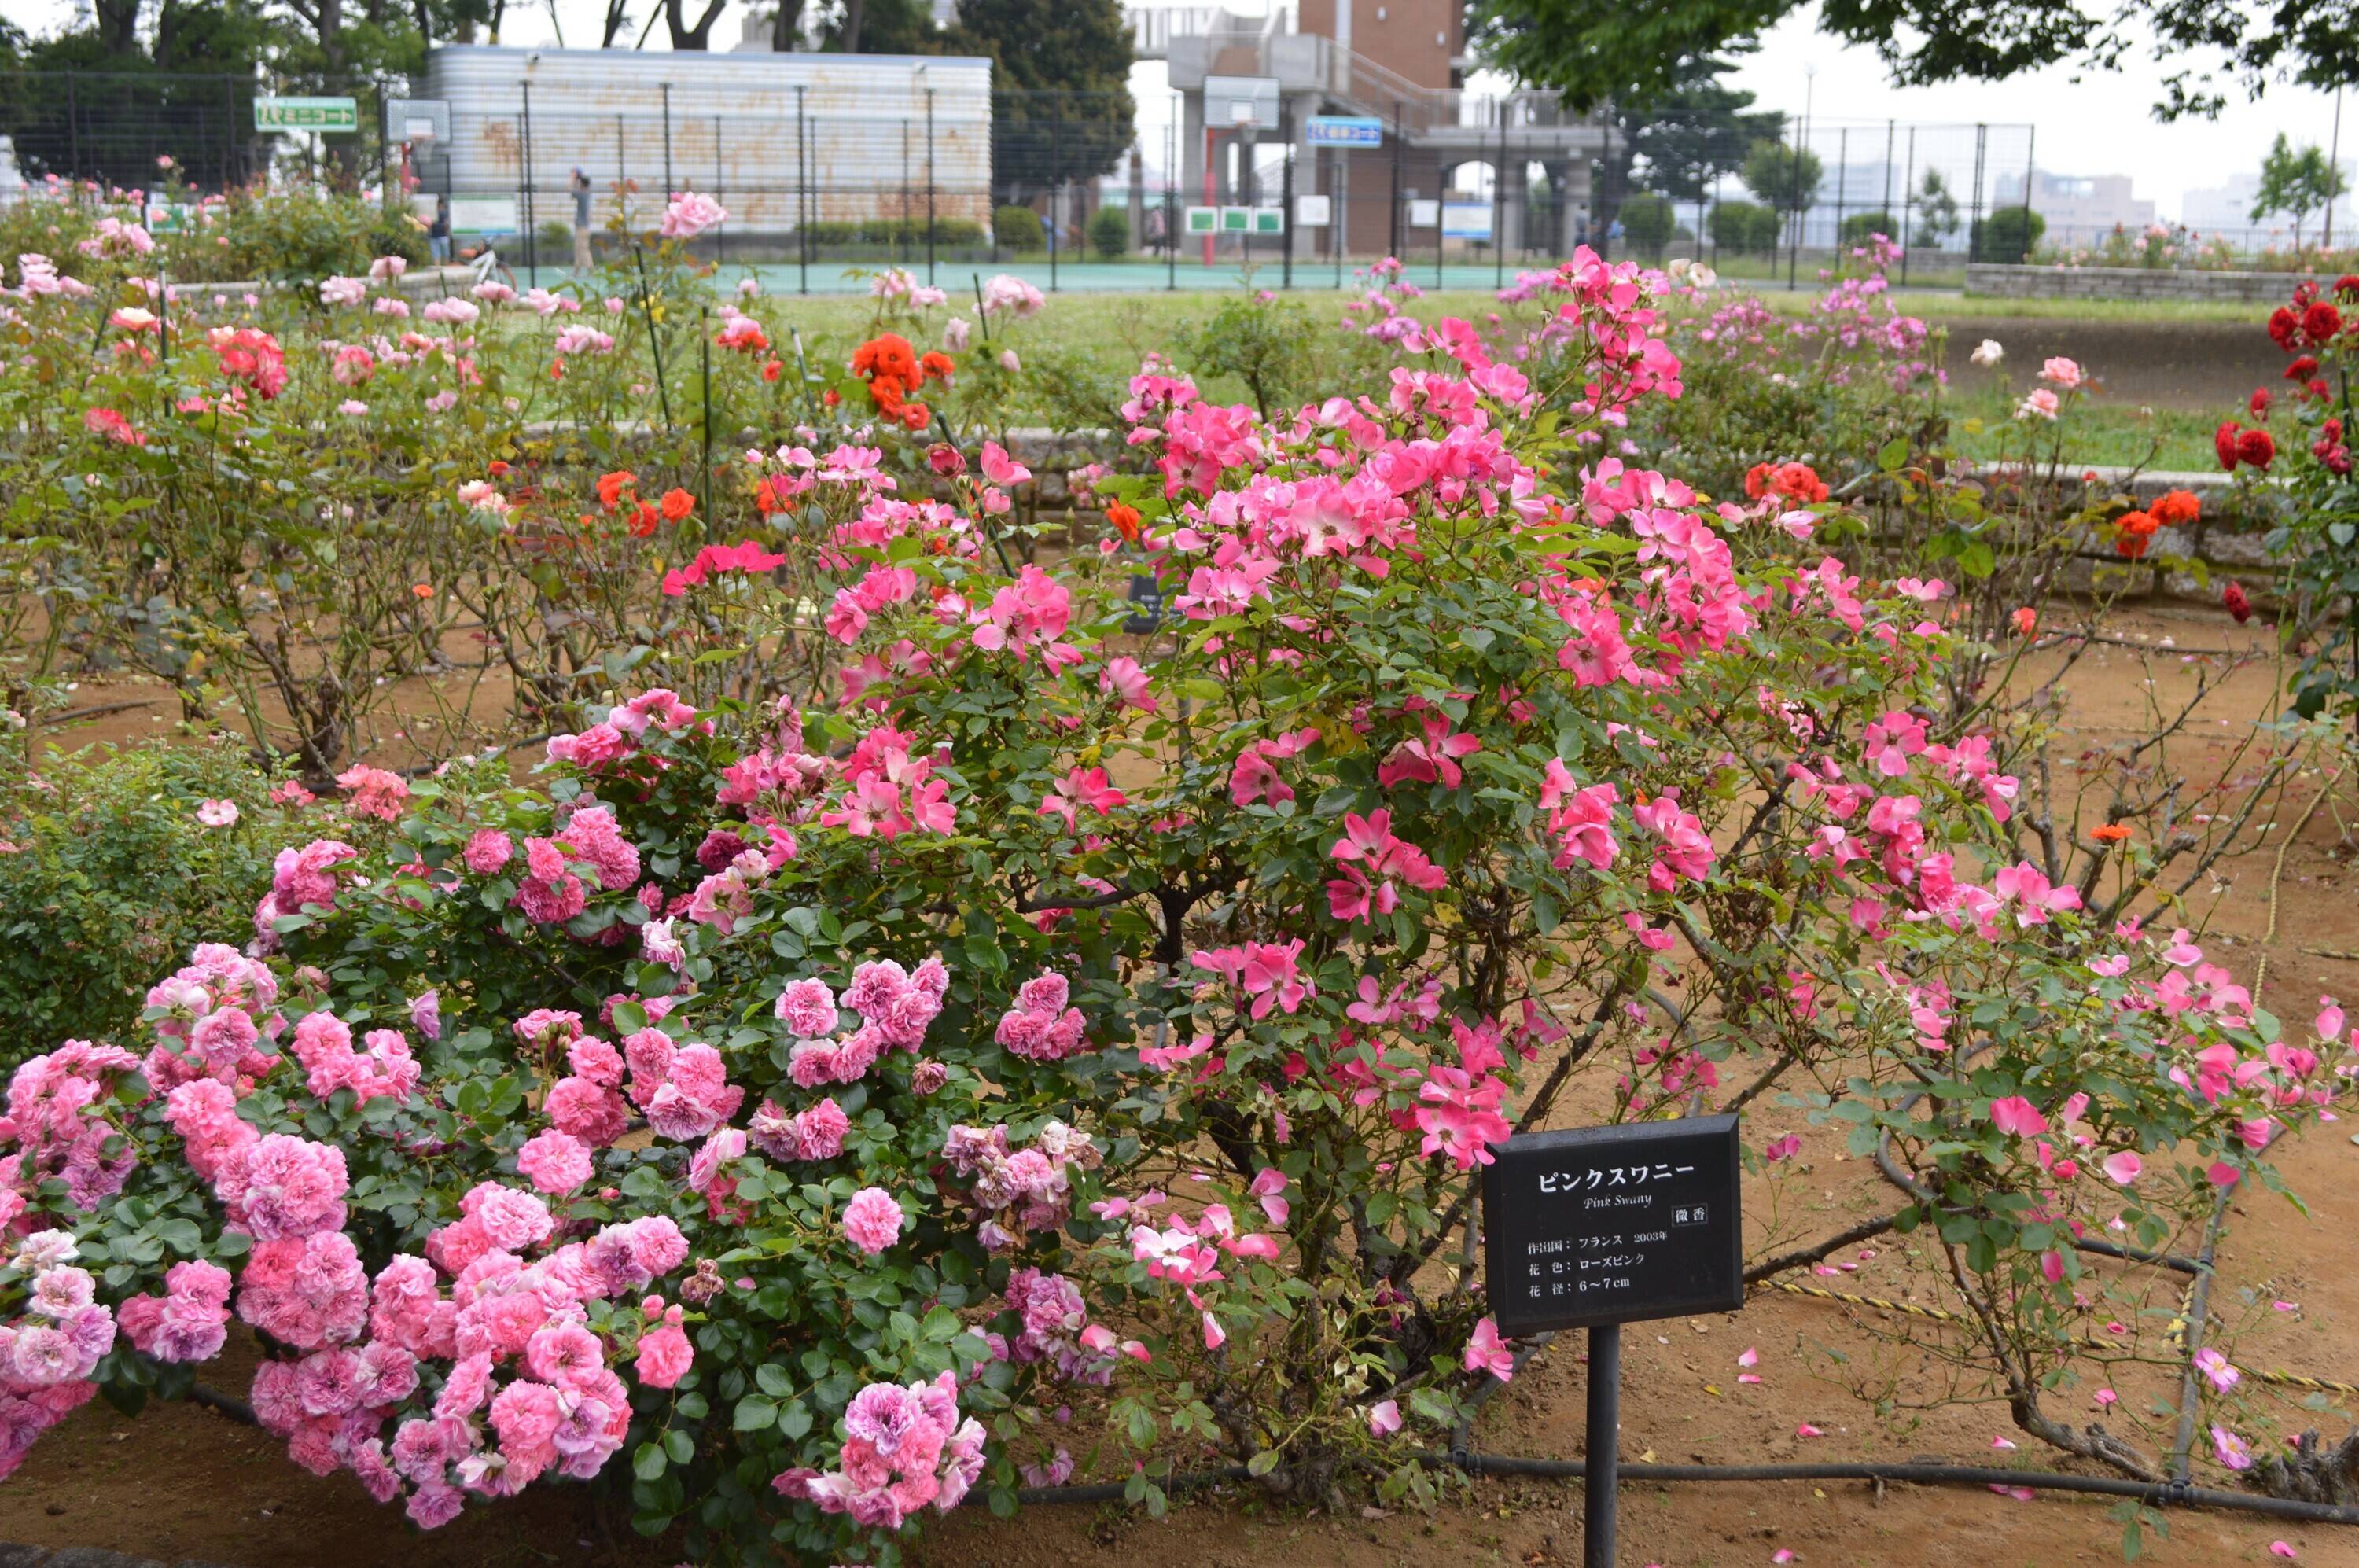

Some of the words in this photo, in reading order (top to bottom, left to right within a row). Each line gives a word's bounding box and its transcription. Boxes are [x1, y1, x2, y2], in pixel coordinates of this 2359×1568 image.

[1539, 1163, 1695, 1193] ピンクスワニー
[1584, 1194, 1611, 1209] Pink
[1614, 1194, 1652, 1209] Swany
[1578, 1235, 1622, 1249] フランス
[1634, 1231, 1668, 1243] 2003年
